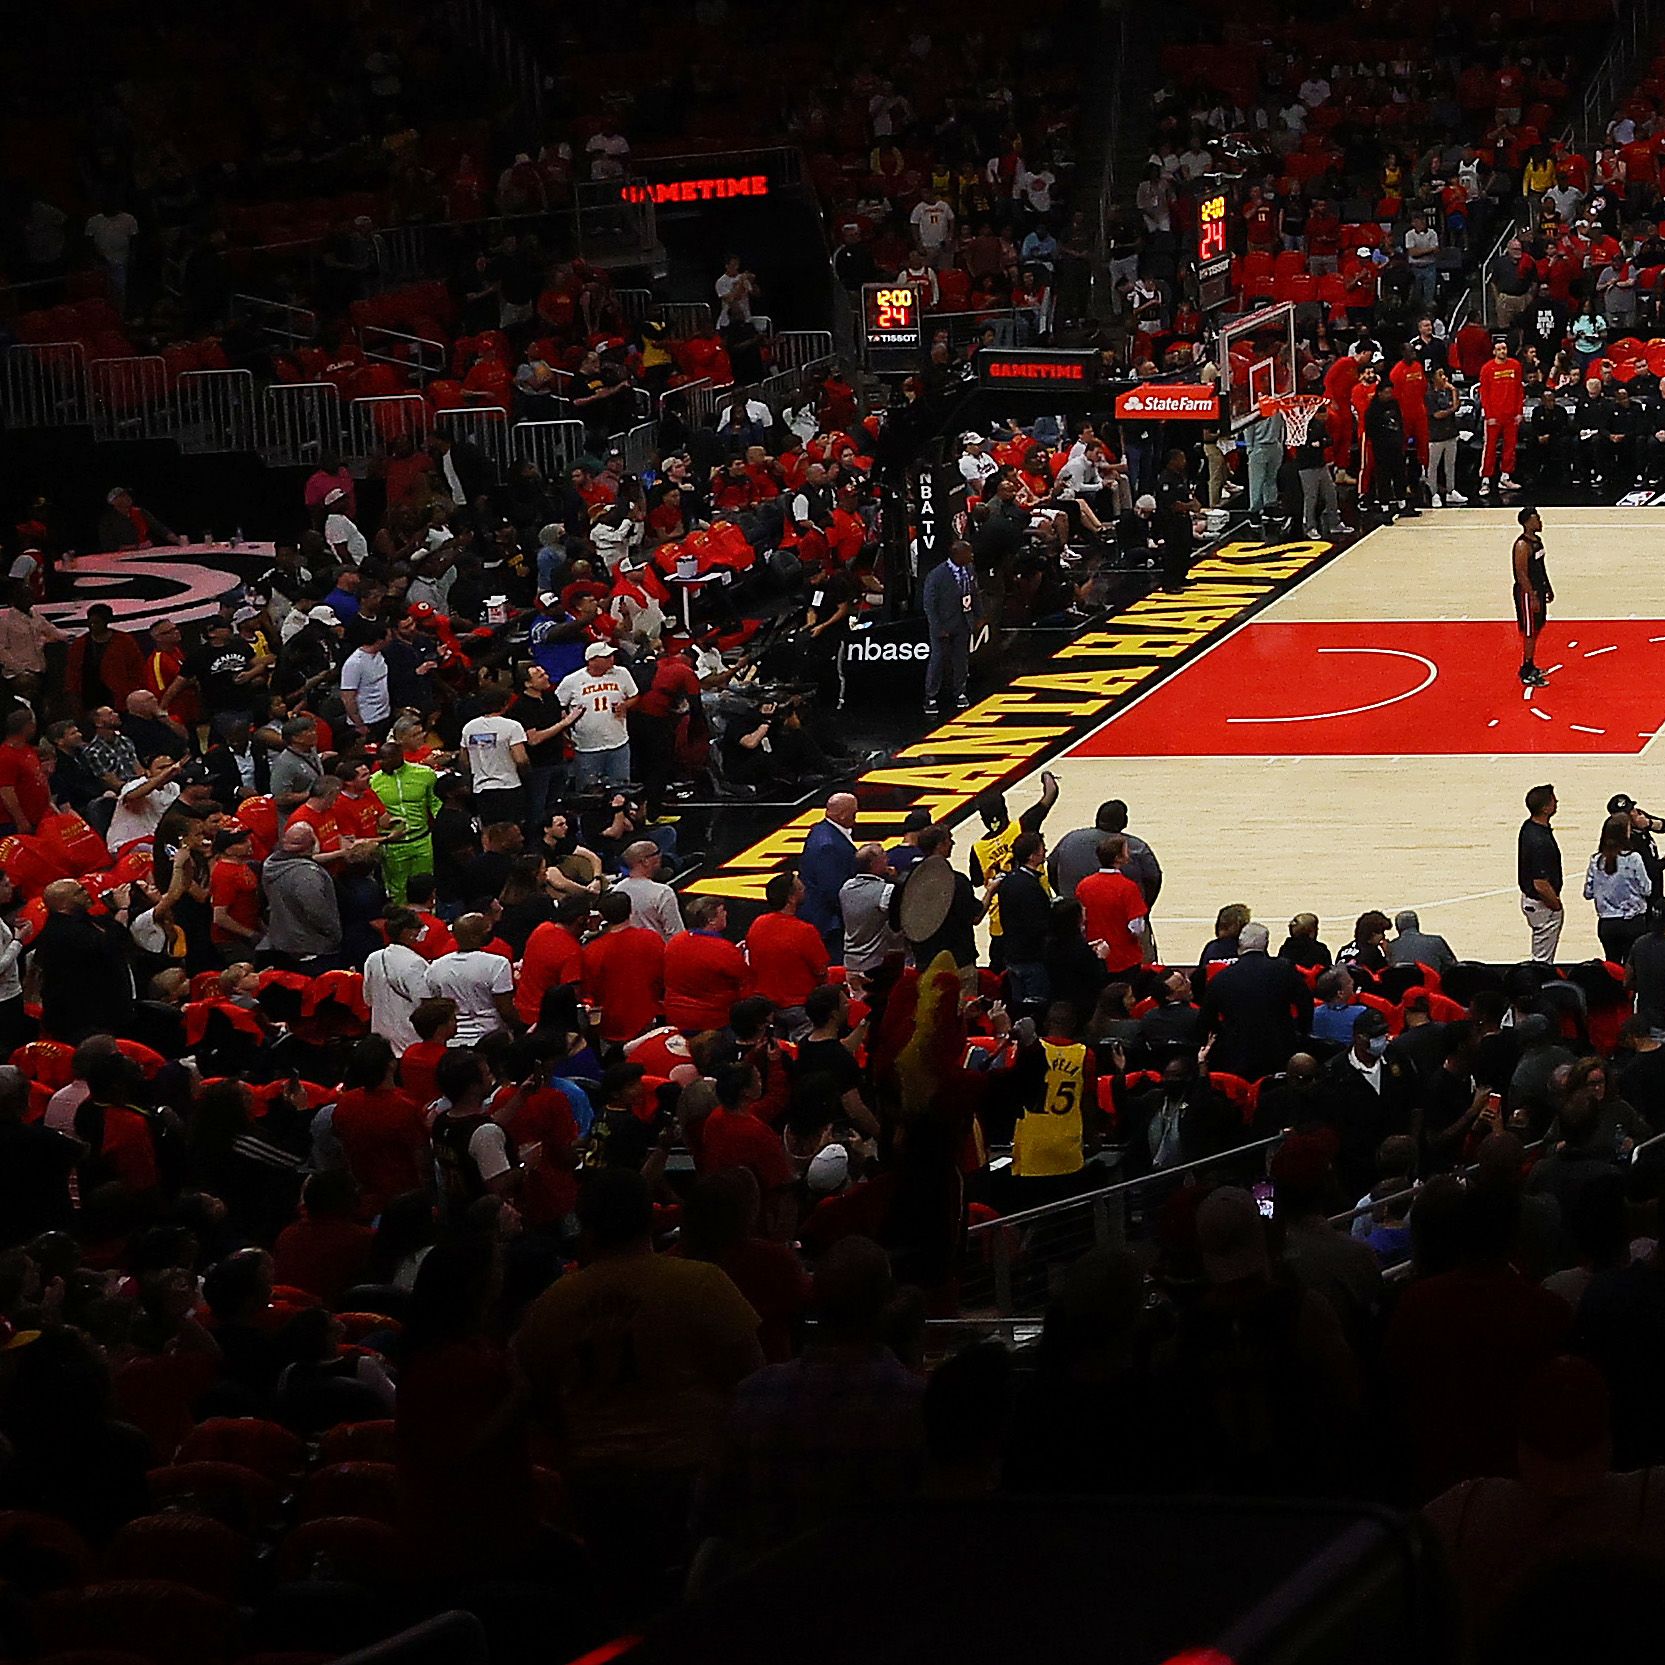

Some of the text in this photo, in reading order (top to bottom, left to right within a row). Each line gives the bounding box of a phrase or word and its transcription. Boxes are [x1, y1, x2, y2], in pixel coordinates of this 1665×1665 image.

[1201, 221, 1223, 260] 24
[877, 289, 912, 307] 12:00
[879, 306, 905, 327] 24
[881, 334, 917, 343] TISSOT
[990, 364, 1083, 380] GAMETIME
[919, 473, 936, 550] NBA TV
[1052, 539, 1334, 660] HAWKS
[847, 636, 930, 661] nbase
[582, 682, 620, 696] ATLANTA
[593, 697, 608, 712] 11
[1051, 1057, 1080, 1077] PELA
[1044, 1081, 1076, 1116] 15
